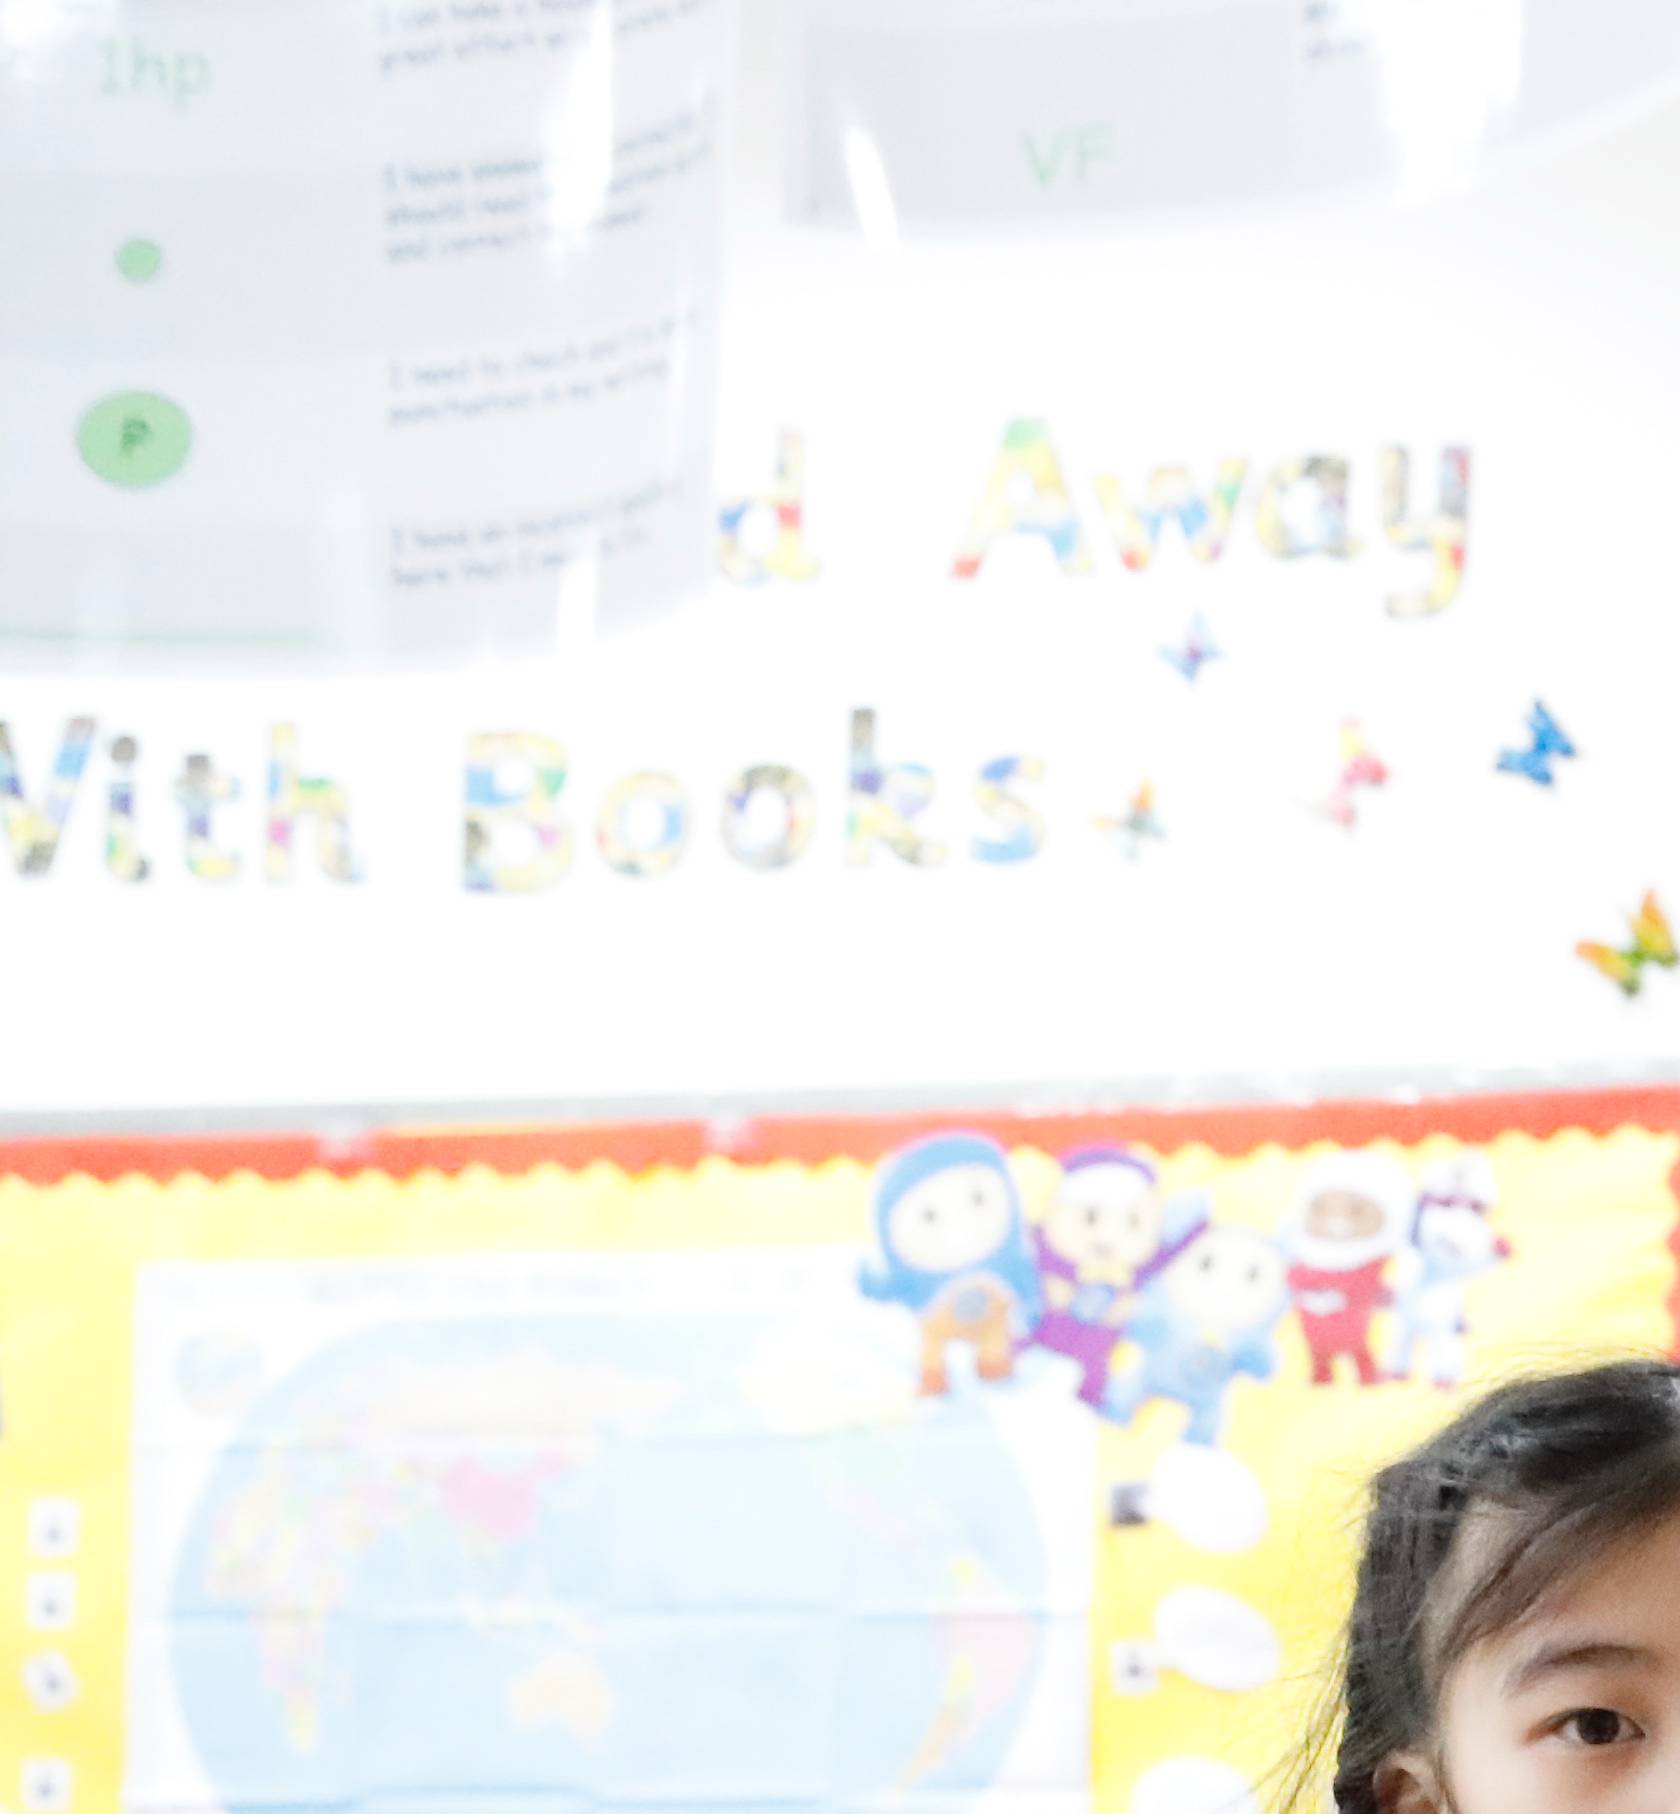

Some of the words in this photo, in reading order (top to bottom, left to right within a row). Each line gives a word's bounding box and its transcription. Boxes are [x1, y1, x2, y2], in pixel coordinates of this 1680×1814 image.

[1021, 120, 1119, 188] VF
[949, 415, 1473, 621] Away
[460, 704, 1047, 896] Books
